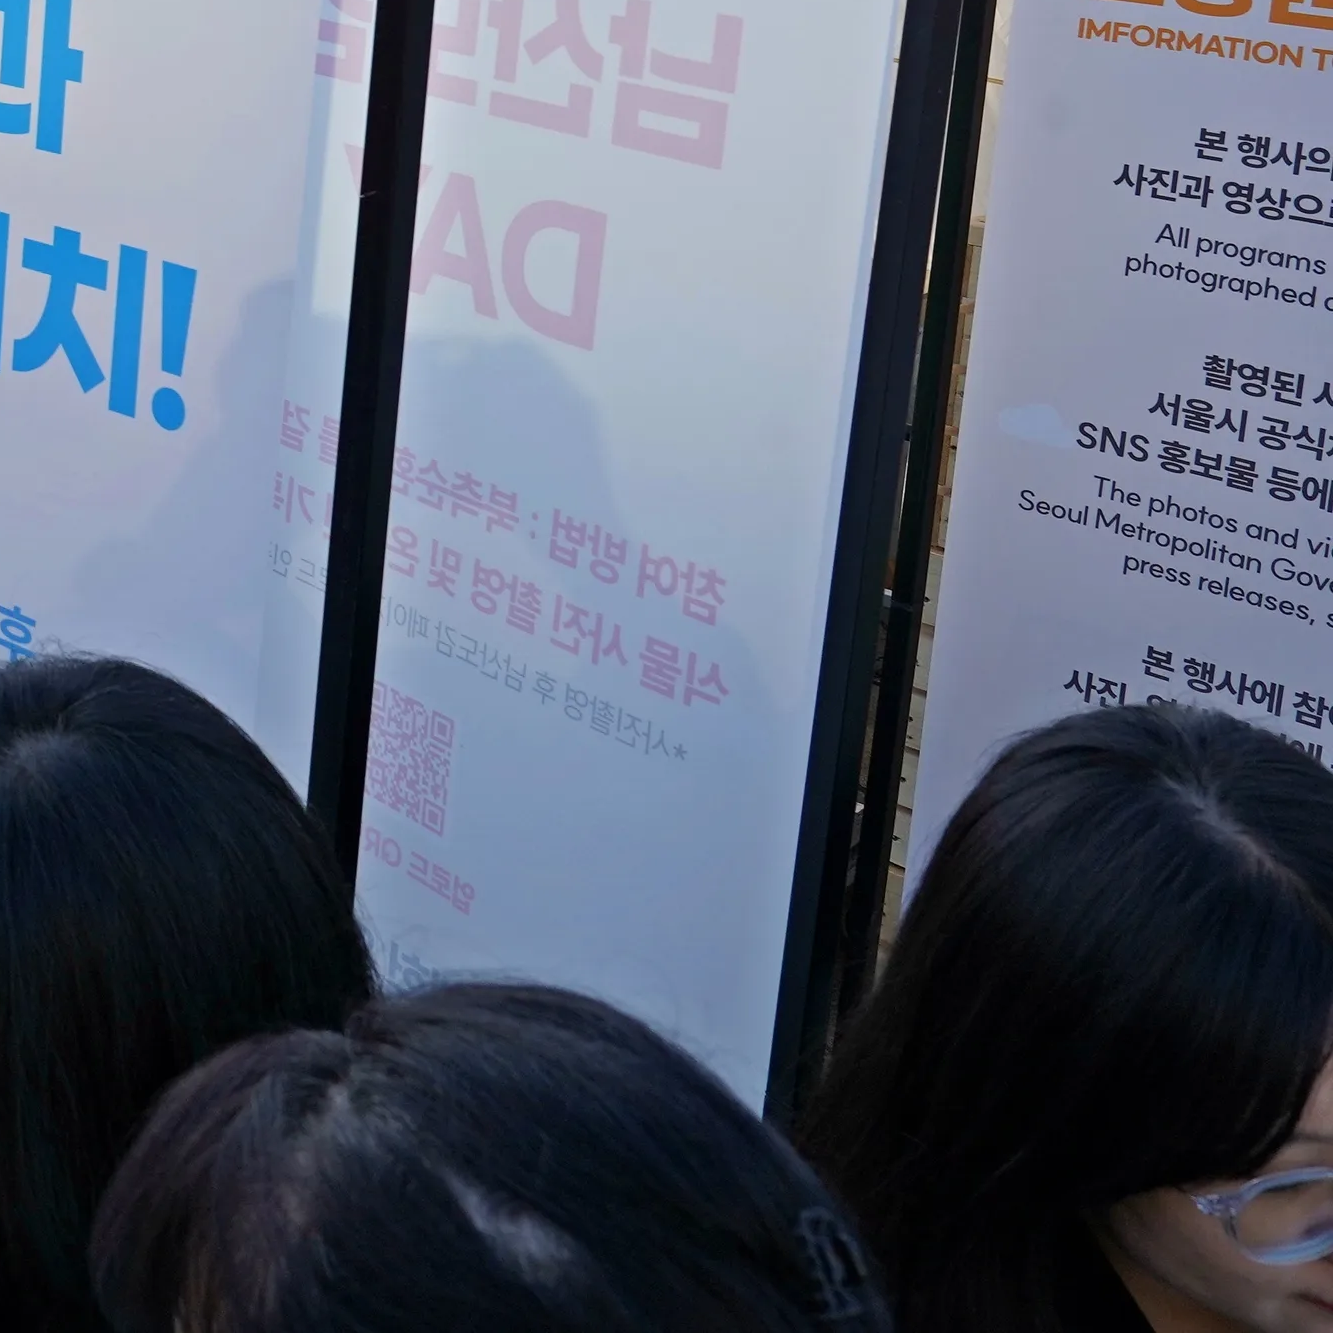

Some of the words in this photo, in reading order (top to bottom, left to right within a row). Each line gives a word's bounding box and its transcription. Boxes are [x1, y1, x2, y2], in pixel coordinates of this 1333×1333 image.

[1077, 17, 1304, 70] IMFORMATION
[1312, 48, 1333, 73] T
[1194, 128, 1228, 162] 본
[1113, 163, 1214, 208] 사진과
[1222, 181, 1333, 228] 영상으
[1124, 252, 1318, 308] photographed
[1154, 223, 1190, 249] All
[1195, 236, 1327, 275] programs
[1202, 354, 1305, 407] 촬영된
[1076, 421, 1150, 463] SNS
[1157, 439, 1259, 494] 홍보물
[1148, 391, 1249, 443] 서울시
[1256, 415, 1333, 462] 공식
[1018, 490, 1089, 527] Seoul
[1095, 508, 1262, 575] Metropolitan
[1093, 474, 1141, 507] The
[1147, 495, 1238, 534] photos
[1245, 523, 1299, 550] and
[1122, 555, 1191, 588] press
[1198, 577, 1316, 627] releases,
[1142, 645, 1175, 682] 본
[1183, 657, 1285, 717] 행사에
[1292, 690, 1333, 729] 참
